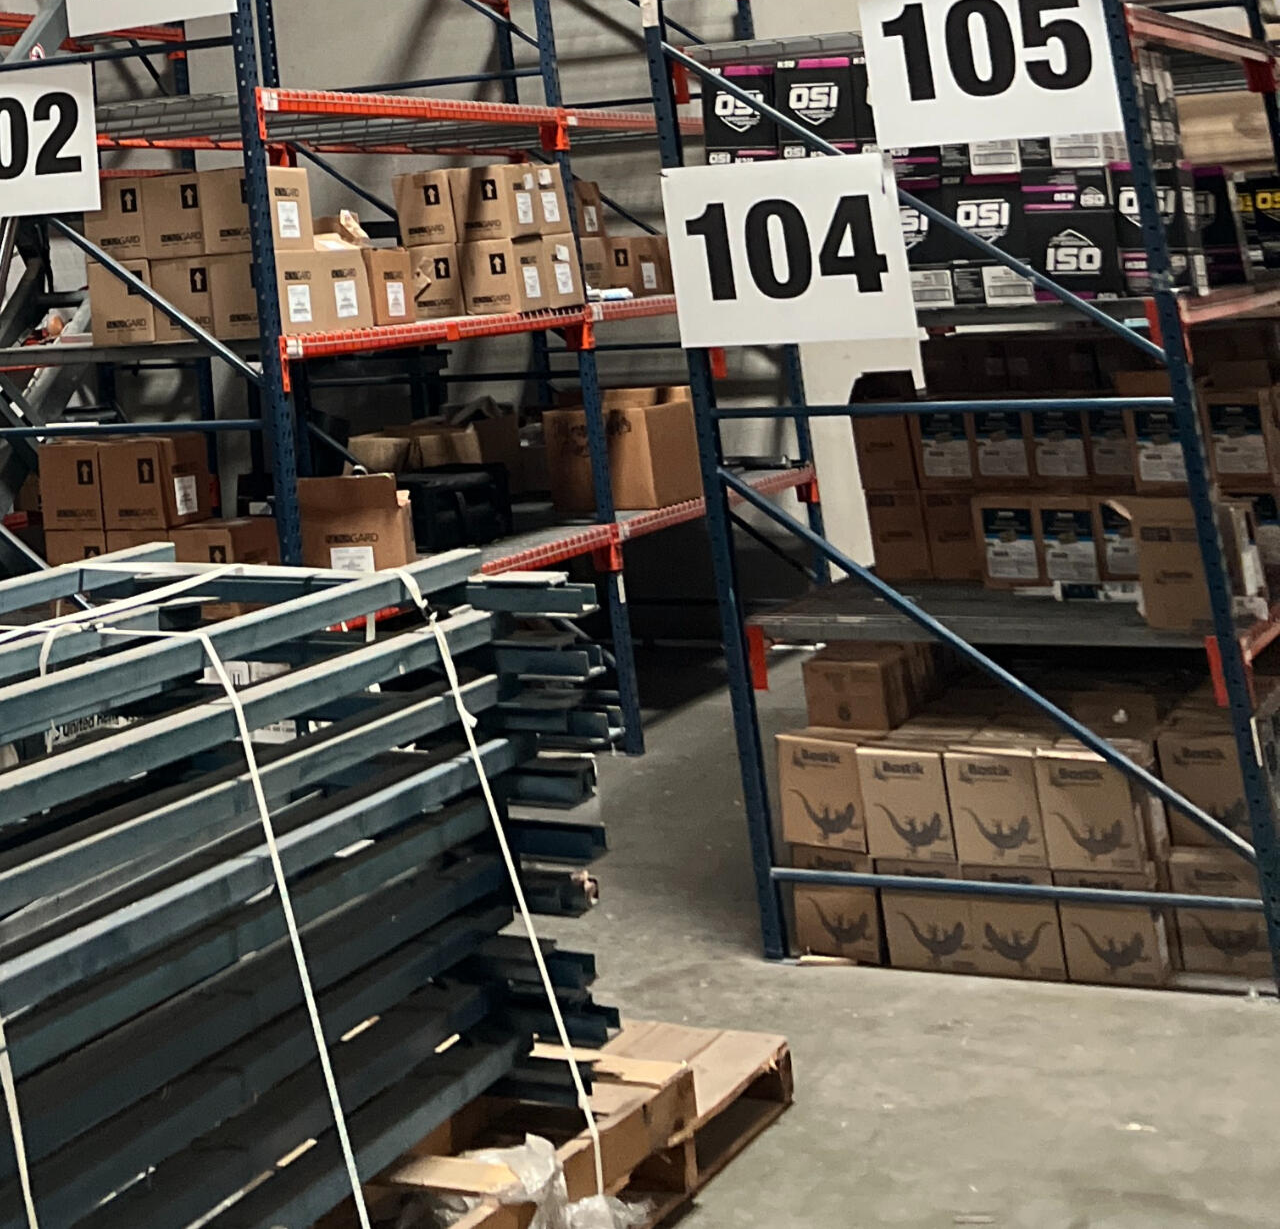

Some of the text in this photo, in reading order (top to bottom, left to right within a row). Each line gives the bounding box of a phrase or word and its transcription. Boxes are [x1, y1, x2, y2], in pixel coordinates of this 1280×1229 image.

[789, 85, 839, 110] OSI
[900, 207, 929, 233] SI
[957, 203, 1010, 227] OSI
[685, 194, 889, 301] 104
